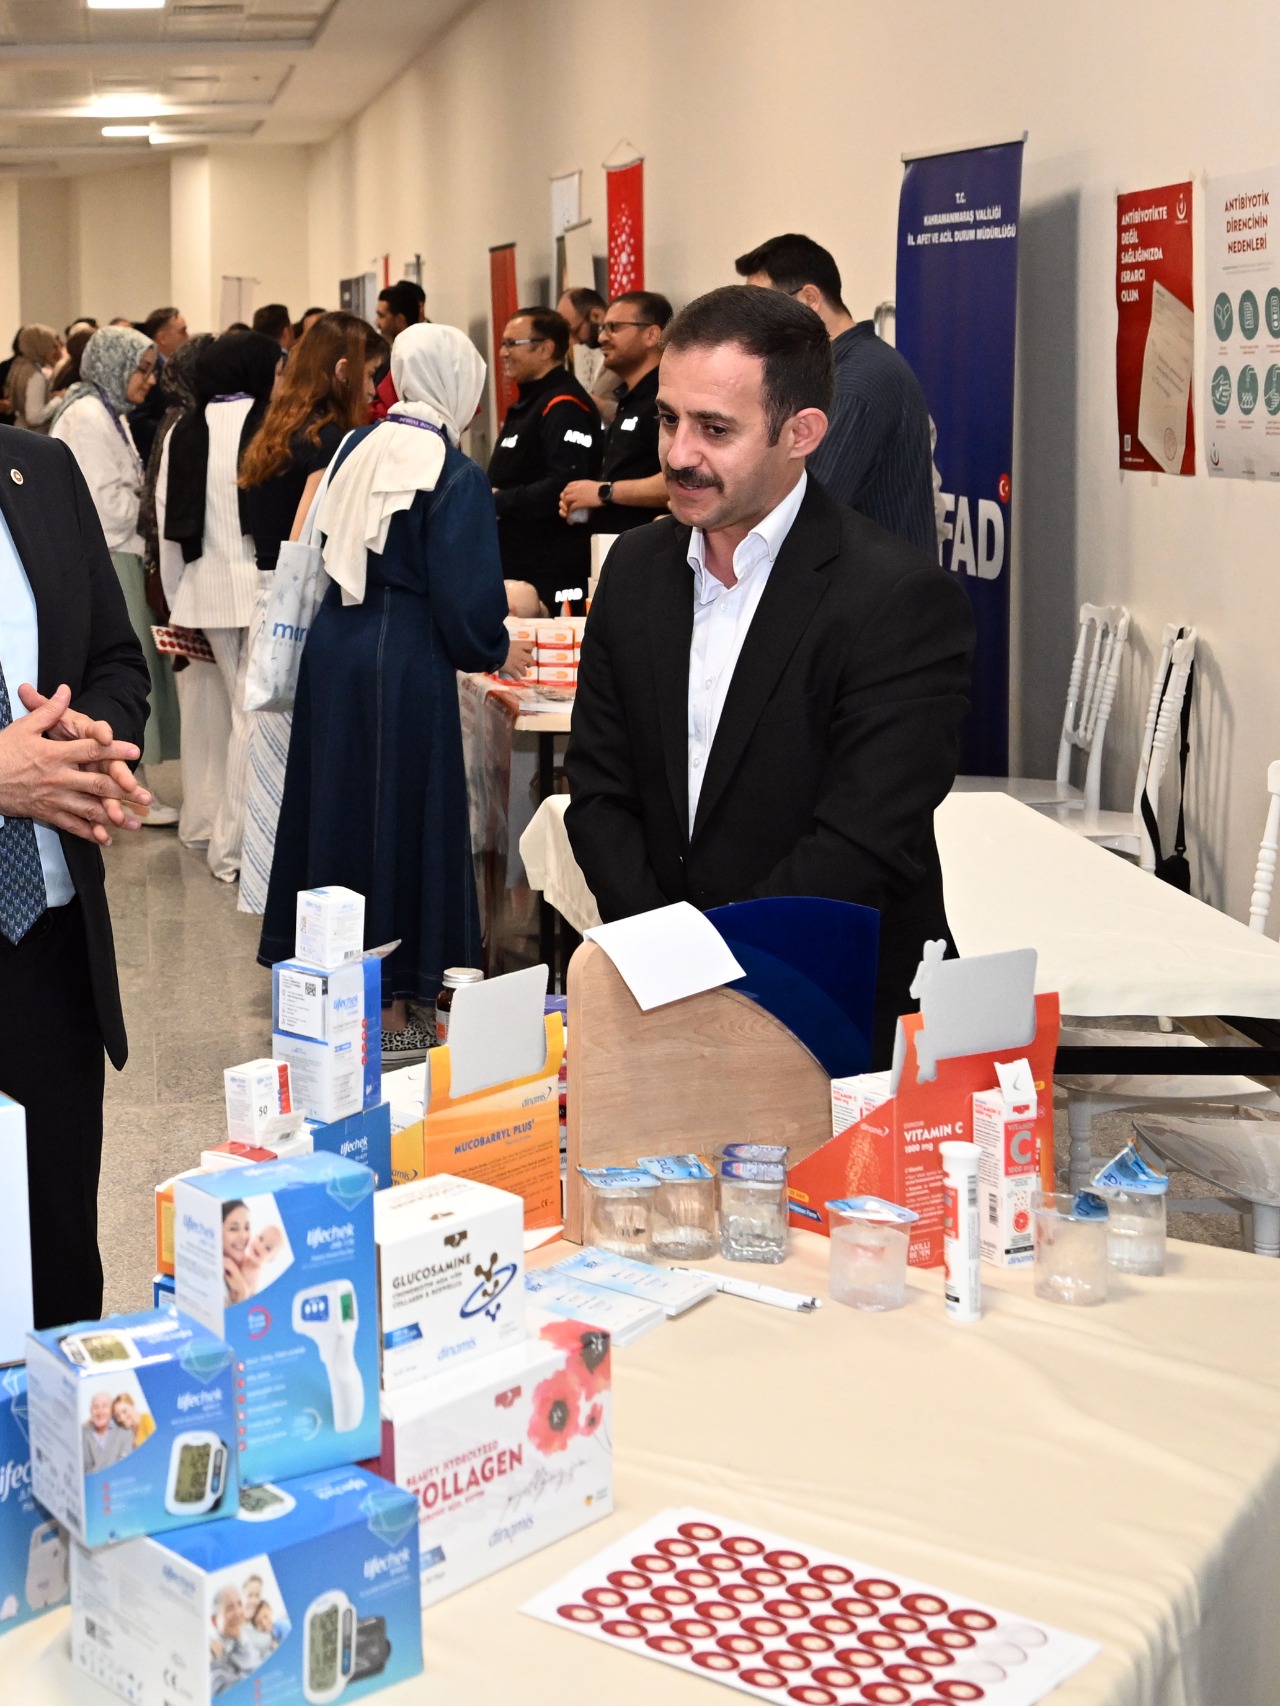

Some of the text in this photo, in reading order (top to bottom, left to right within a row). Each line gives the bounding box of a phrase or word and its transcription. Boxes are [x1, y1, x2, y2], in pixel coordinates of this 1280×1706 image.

[1225, 190, 1269, 212] ANTİBİYOTİK
[924, 210, 974, 226] KAHRAMANMARAŞ
[1121, 204, 1167, 226] ANTİBİYOTİKTE
[1226, 212, 1268, 233] DİRENCİNİN
[1121, 228, 1139, 245] DEĞİL
[1228, 233, 1267, 255] NEDENLERİ
[1121, 247, 1163, 265] SAĞLIĞINIZDA
[1121, 289, 1139, 303] OLUN
[937, 491, 1005, 580] FAD
[258, 1104, 268, 1117] 50
[454, 1128, 511, 1154] MUCOBARRYL
[904, 1124, 952, 1143] VITAMIN
[955, 1121, 963, 1134] C
[904, 1142, 934, 1154] 1000 mg
[1010, 1130, 1032, 1165] C
[393, 1253, 472, 1289] GLUCOSAMINE
